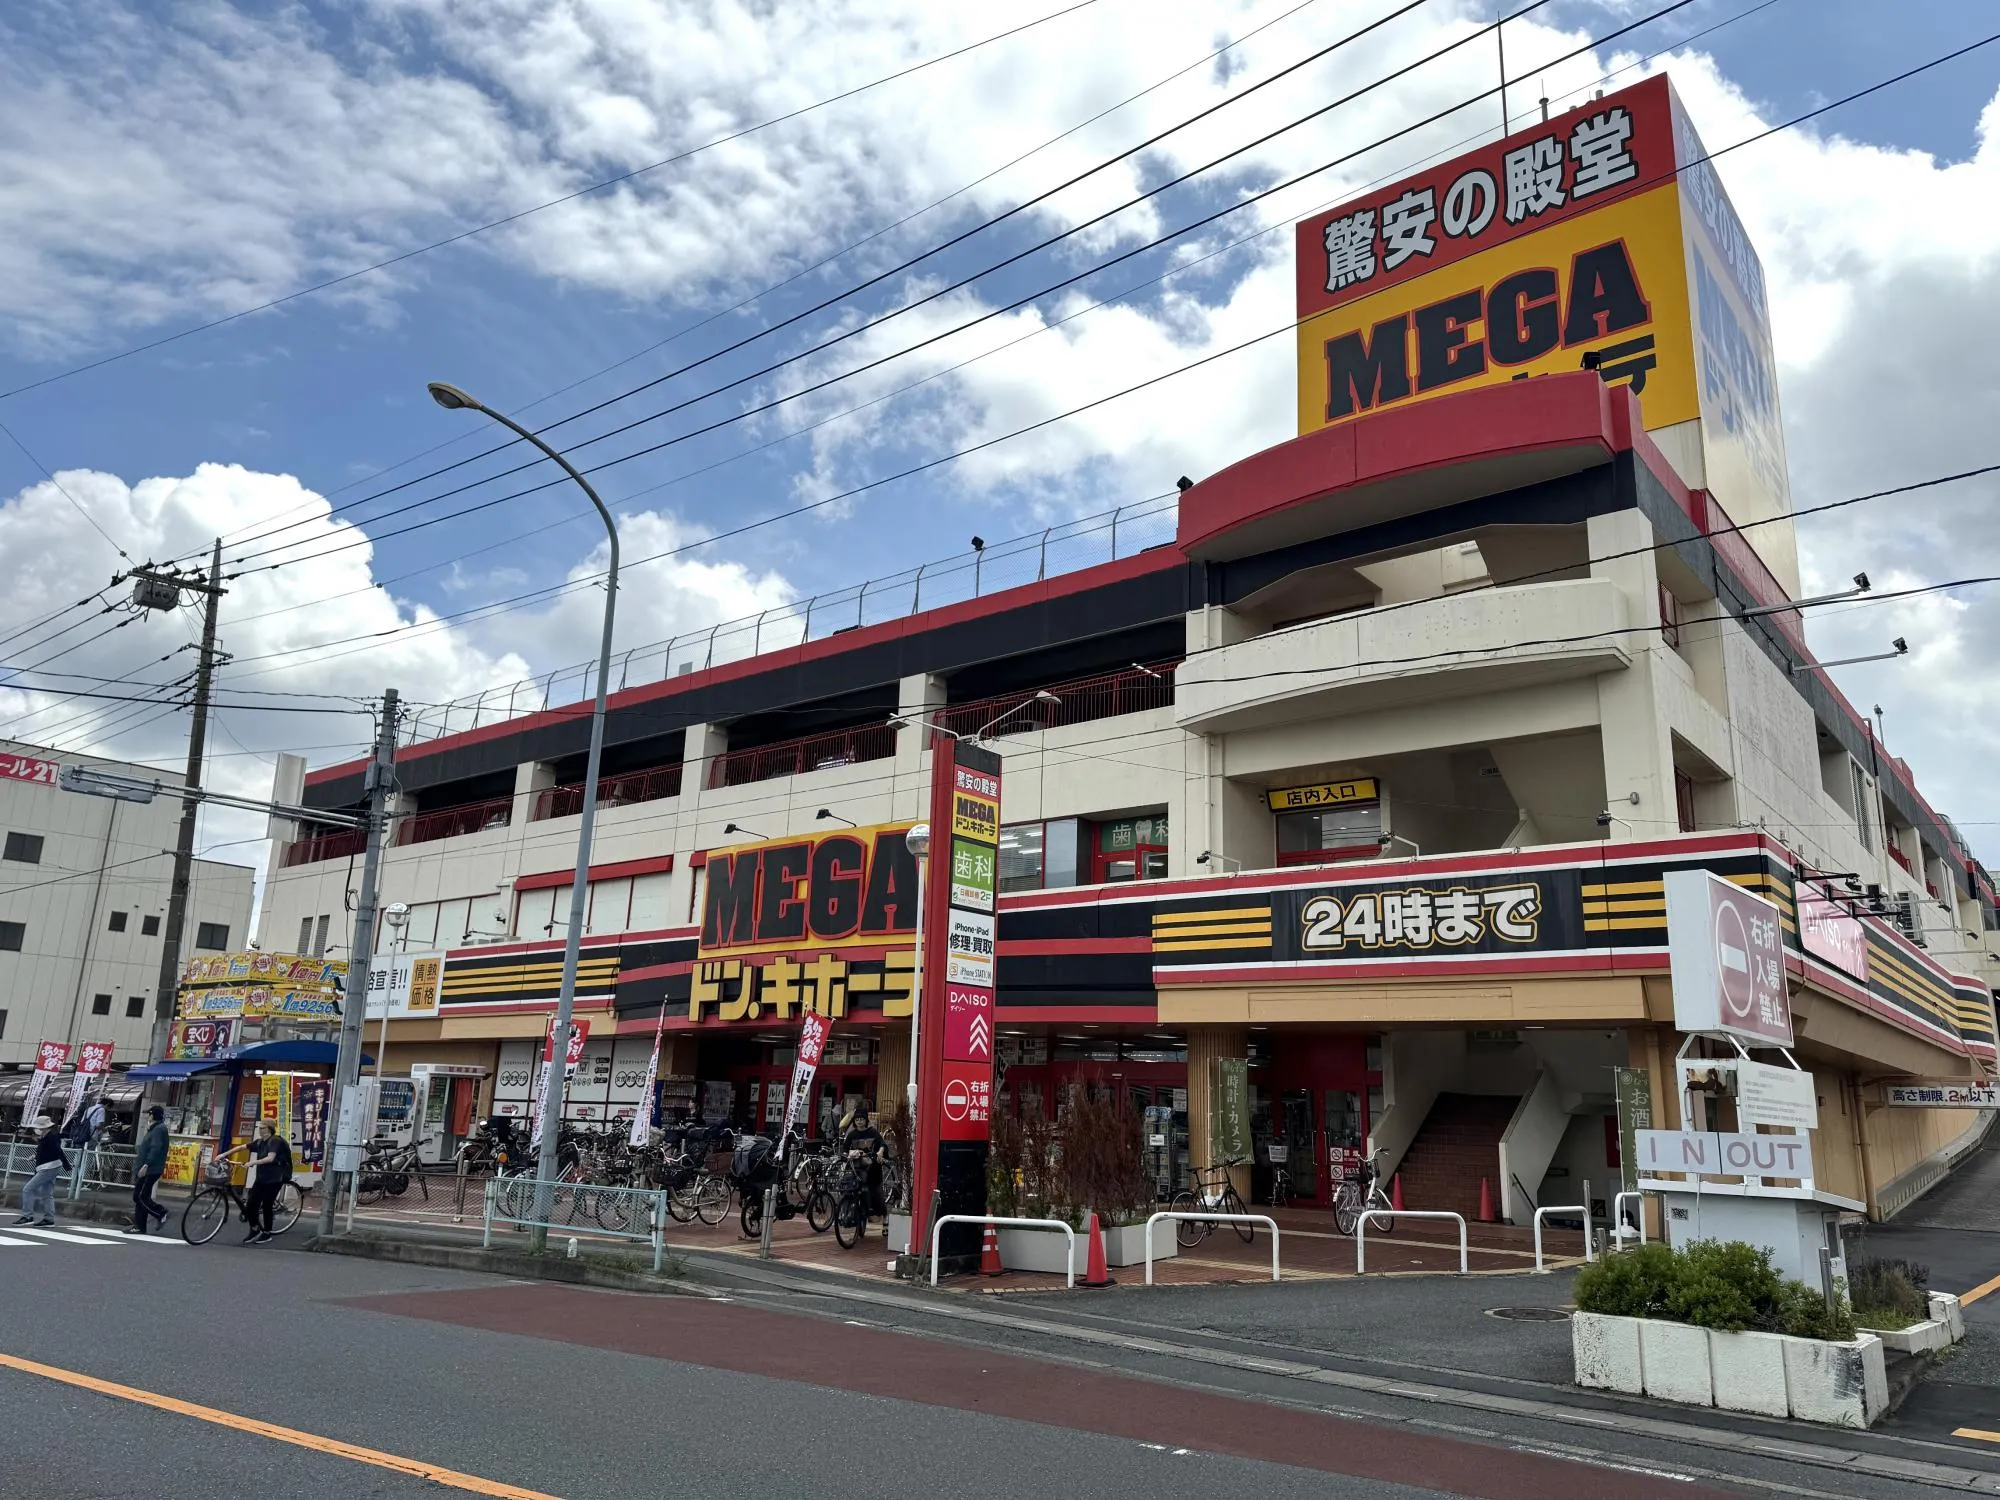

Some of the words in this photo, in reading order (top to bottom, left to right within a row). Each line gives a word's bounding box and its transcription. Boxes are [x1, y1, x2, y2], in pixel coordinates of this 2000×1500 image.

[1324, 107, 1637, 294] 驚安の殿堂
[1324, 237, 1652, 423] MEGA
[957, 771, 997, 797] 驚安の殿堂
[1287, 785, 1356, 805] 店内入口
[957, 797, 995, 824] MEGA
[955, 851, 992, 885] 歯科
[701, 829, 926, 949] MEGA
[981, 891, 992, 901] 2F
[1302, 883, 1541, 951] 24時まで
[1750, 915, 1775, 951] 右折
[1756, 954, 1780, 991] 入場
[950, 991, 987, 1007] DAISO
[1759, 992, 1785, 1028] 禁止
[186, 1026, 210, 1043] 宝くじ
[970, 1081, 989, 1092] 右折
[264, 1100, 278, 1119] 5
[969, 1095, 988, 1107] 入場
[969, 1109, 988, 1121] 禁止
[1630, 1089, 1650, 1128] お酒
[1727, 1141, 1802, 1170] OUT
